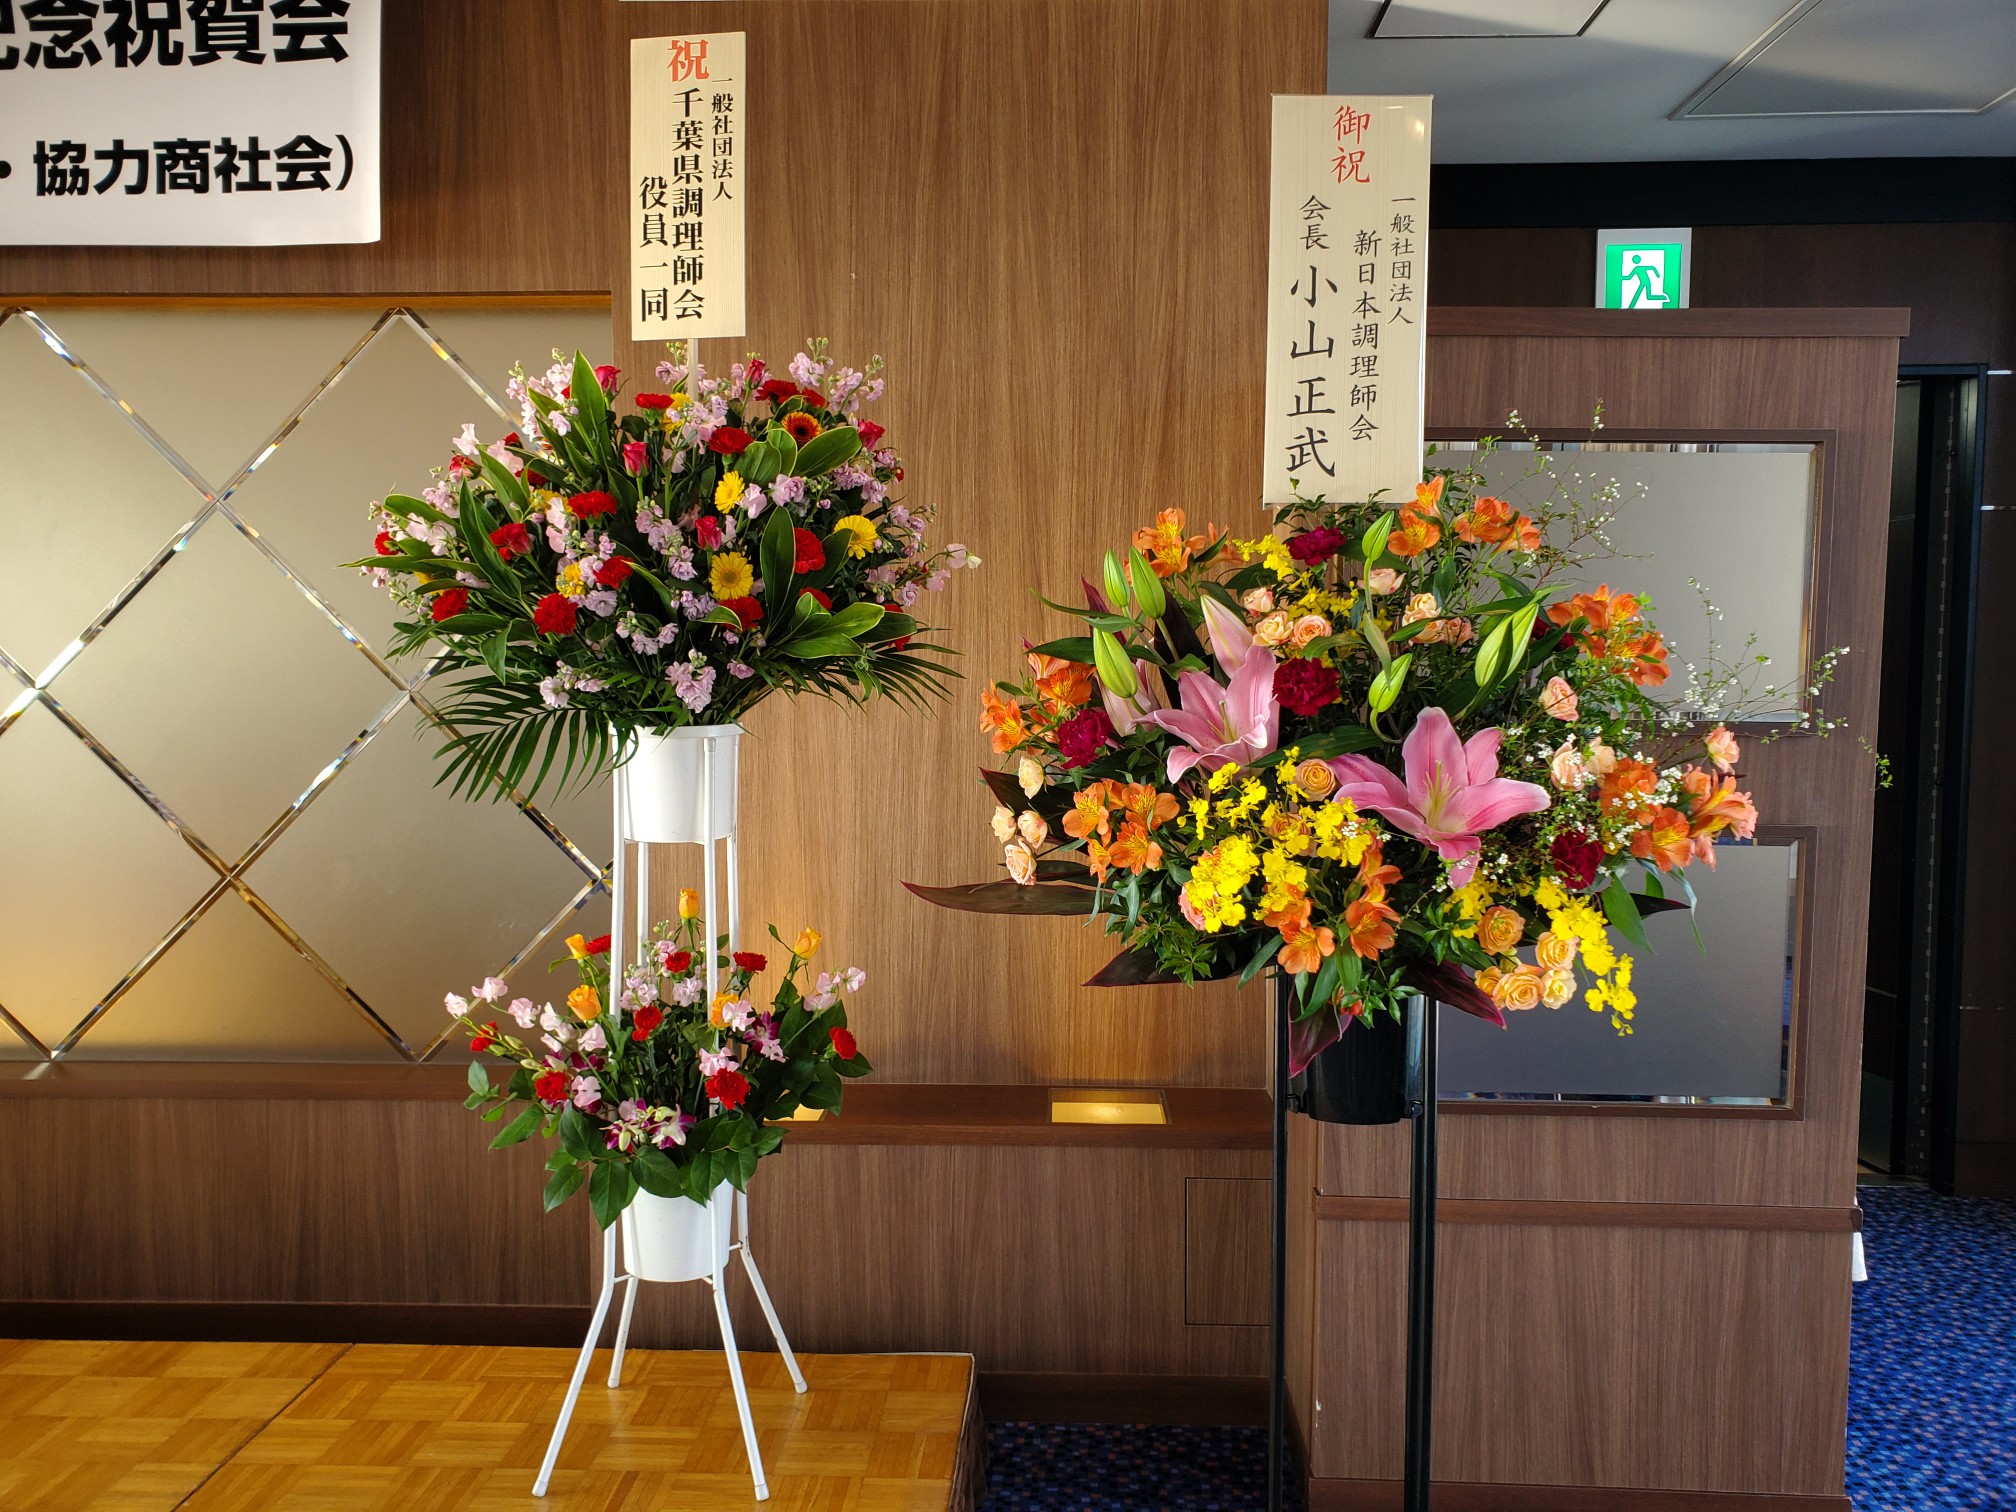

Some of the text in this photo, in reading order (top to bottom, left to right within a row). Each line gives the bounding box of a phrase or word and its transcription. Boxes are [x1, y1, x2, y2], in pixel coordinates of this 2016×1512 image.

[0, 0, 350, 70] 念祝賀会
[667, 38, 710, 82] 祝
[711, 77, 734, 201] 一般社団法人
[1330, 105, 1371, 184] 御祝
[639, 175, 668, 322] 役員一同
[672, 87, 705, 320] 千葉県調理師会
[1387, 197, 1416, 325] 一般社団法人
[1285, 194, 1338, 478] 会長 小山正武
[1347, 229, 1382, 441] 新日本調理師会
